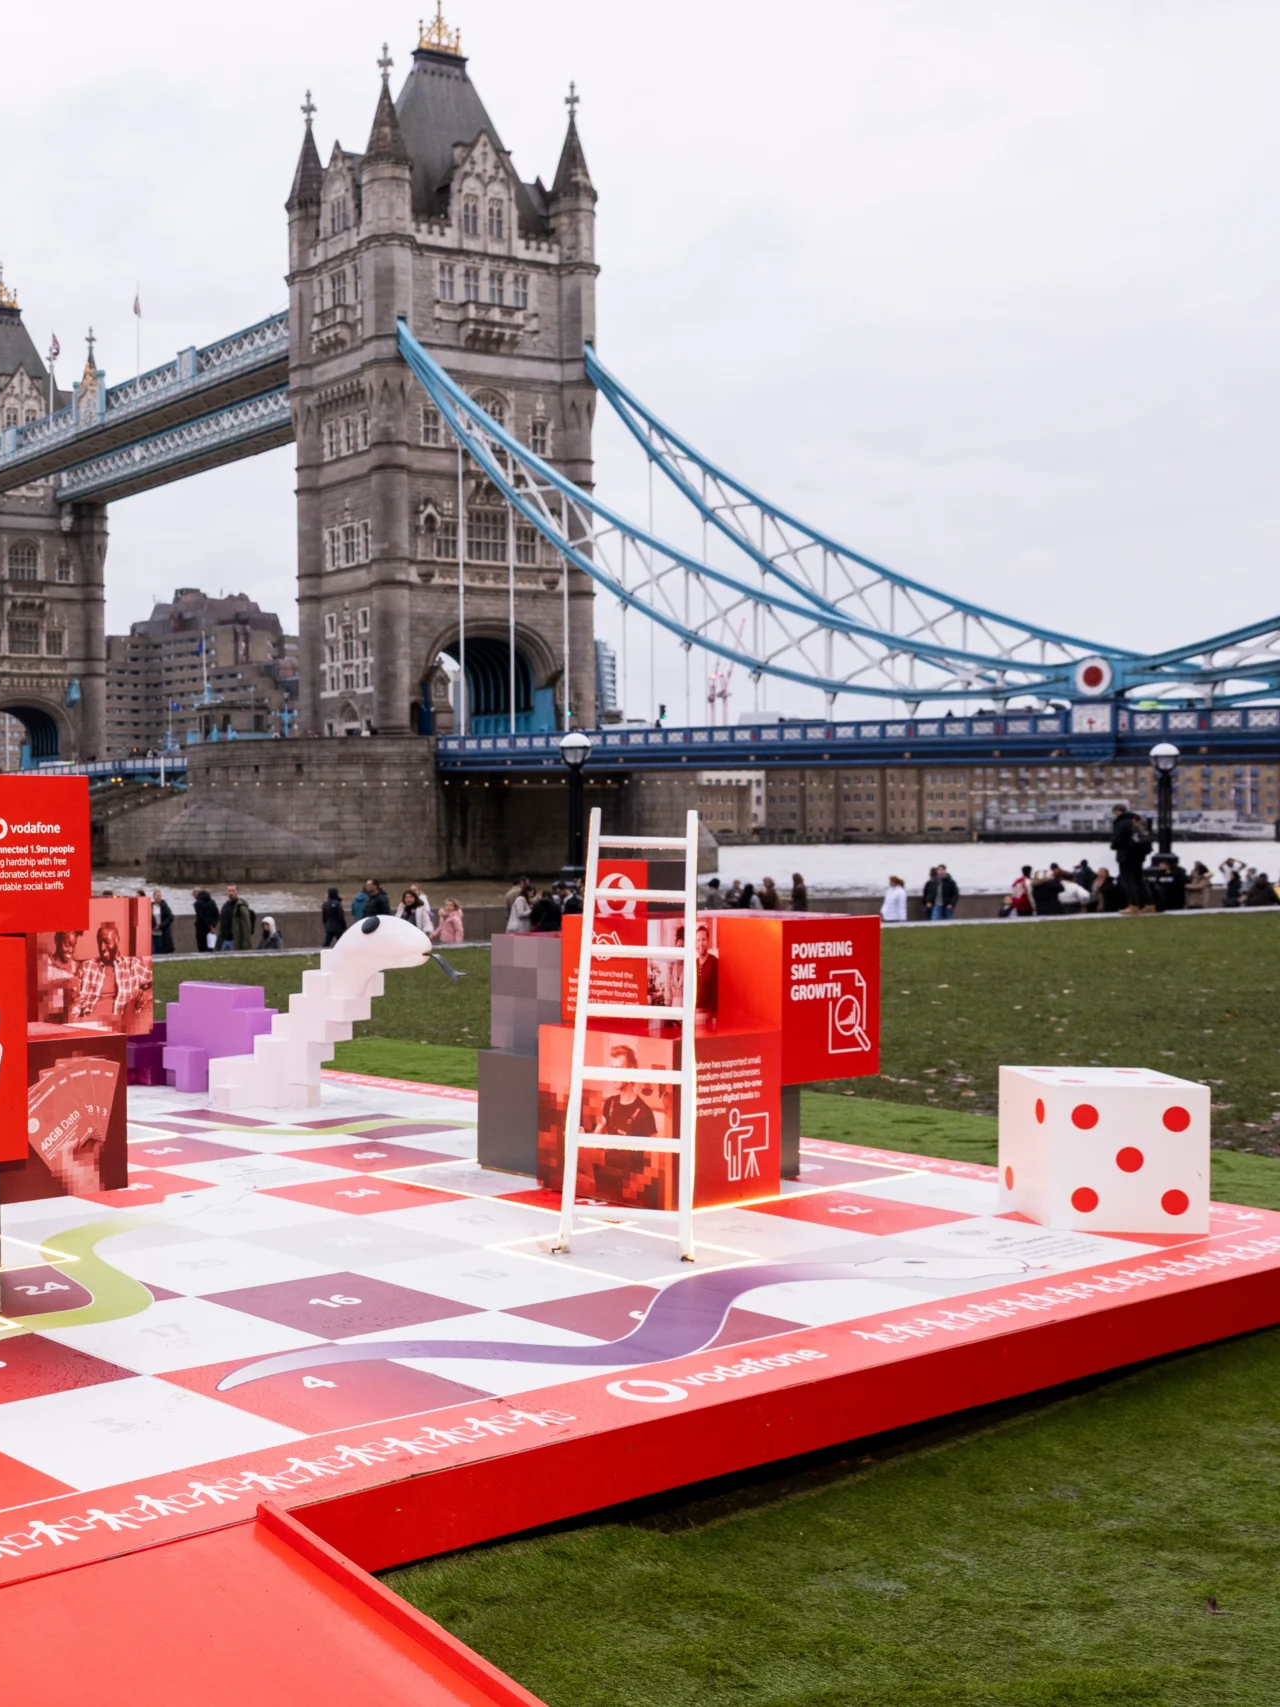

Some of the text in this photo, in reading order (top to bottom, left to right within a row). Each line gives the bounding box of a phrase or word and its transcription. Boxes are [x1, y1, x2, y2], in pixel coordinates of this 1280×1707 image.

[10, 821, 61, 834] vodafone
[30, 844, 48, 854] 1.9m
[49, 844, 75, 855] people
[6, 857, 36, 867] hardship
[37, 857, 52, 866] with
[53, 856, 67, 866] free
[0, 869, 29, 879] donated
[30, 869, 56, 878] devices
[57, 868, 70, 878] and
[23, 881, 43, 891] social
[44, 880, 64, 890] tariffs
[791, 940, 853, 959] POWERING
[599, 970, 623, 979] launched
[624, 971, 634, 980] the
[791, 963, 817, 980] SME
[591, 988, 613, 997] together
[614, 990, 638, 999] founders
[791, 982, 842, 1001] GROWTH
[722, 1057, 747, 1068] supported
[747, 1055, 761, 1065] small
[733, 1068, 760, 1078] businesses
[698, 1085, 710, 1094] free
[733, 1079, 762, 1090] one-to-one
[723, 1092, 740, 1104] digital
[740, 1091, 754, 1100] tools
[40, 1126, 64, 1152] 40GB
[60, 1110, 81, 1131] Data
[334, 1188, 381, 1199] 34
[827, 1203, 874, 1216] 12
[13, 1281, 71, 1297] 24
[308, 1293, 363, 1308] 16
[672, 1348, 829, 1387] vodafone
[301, 1374, 339, 1389] 4
